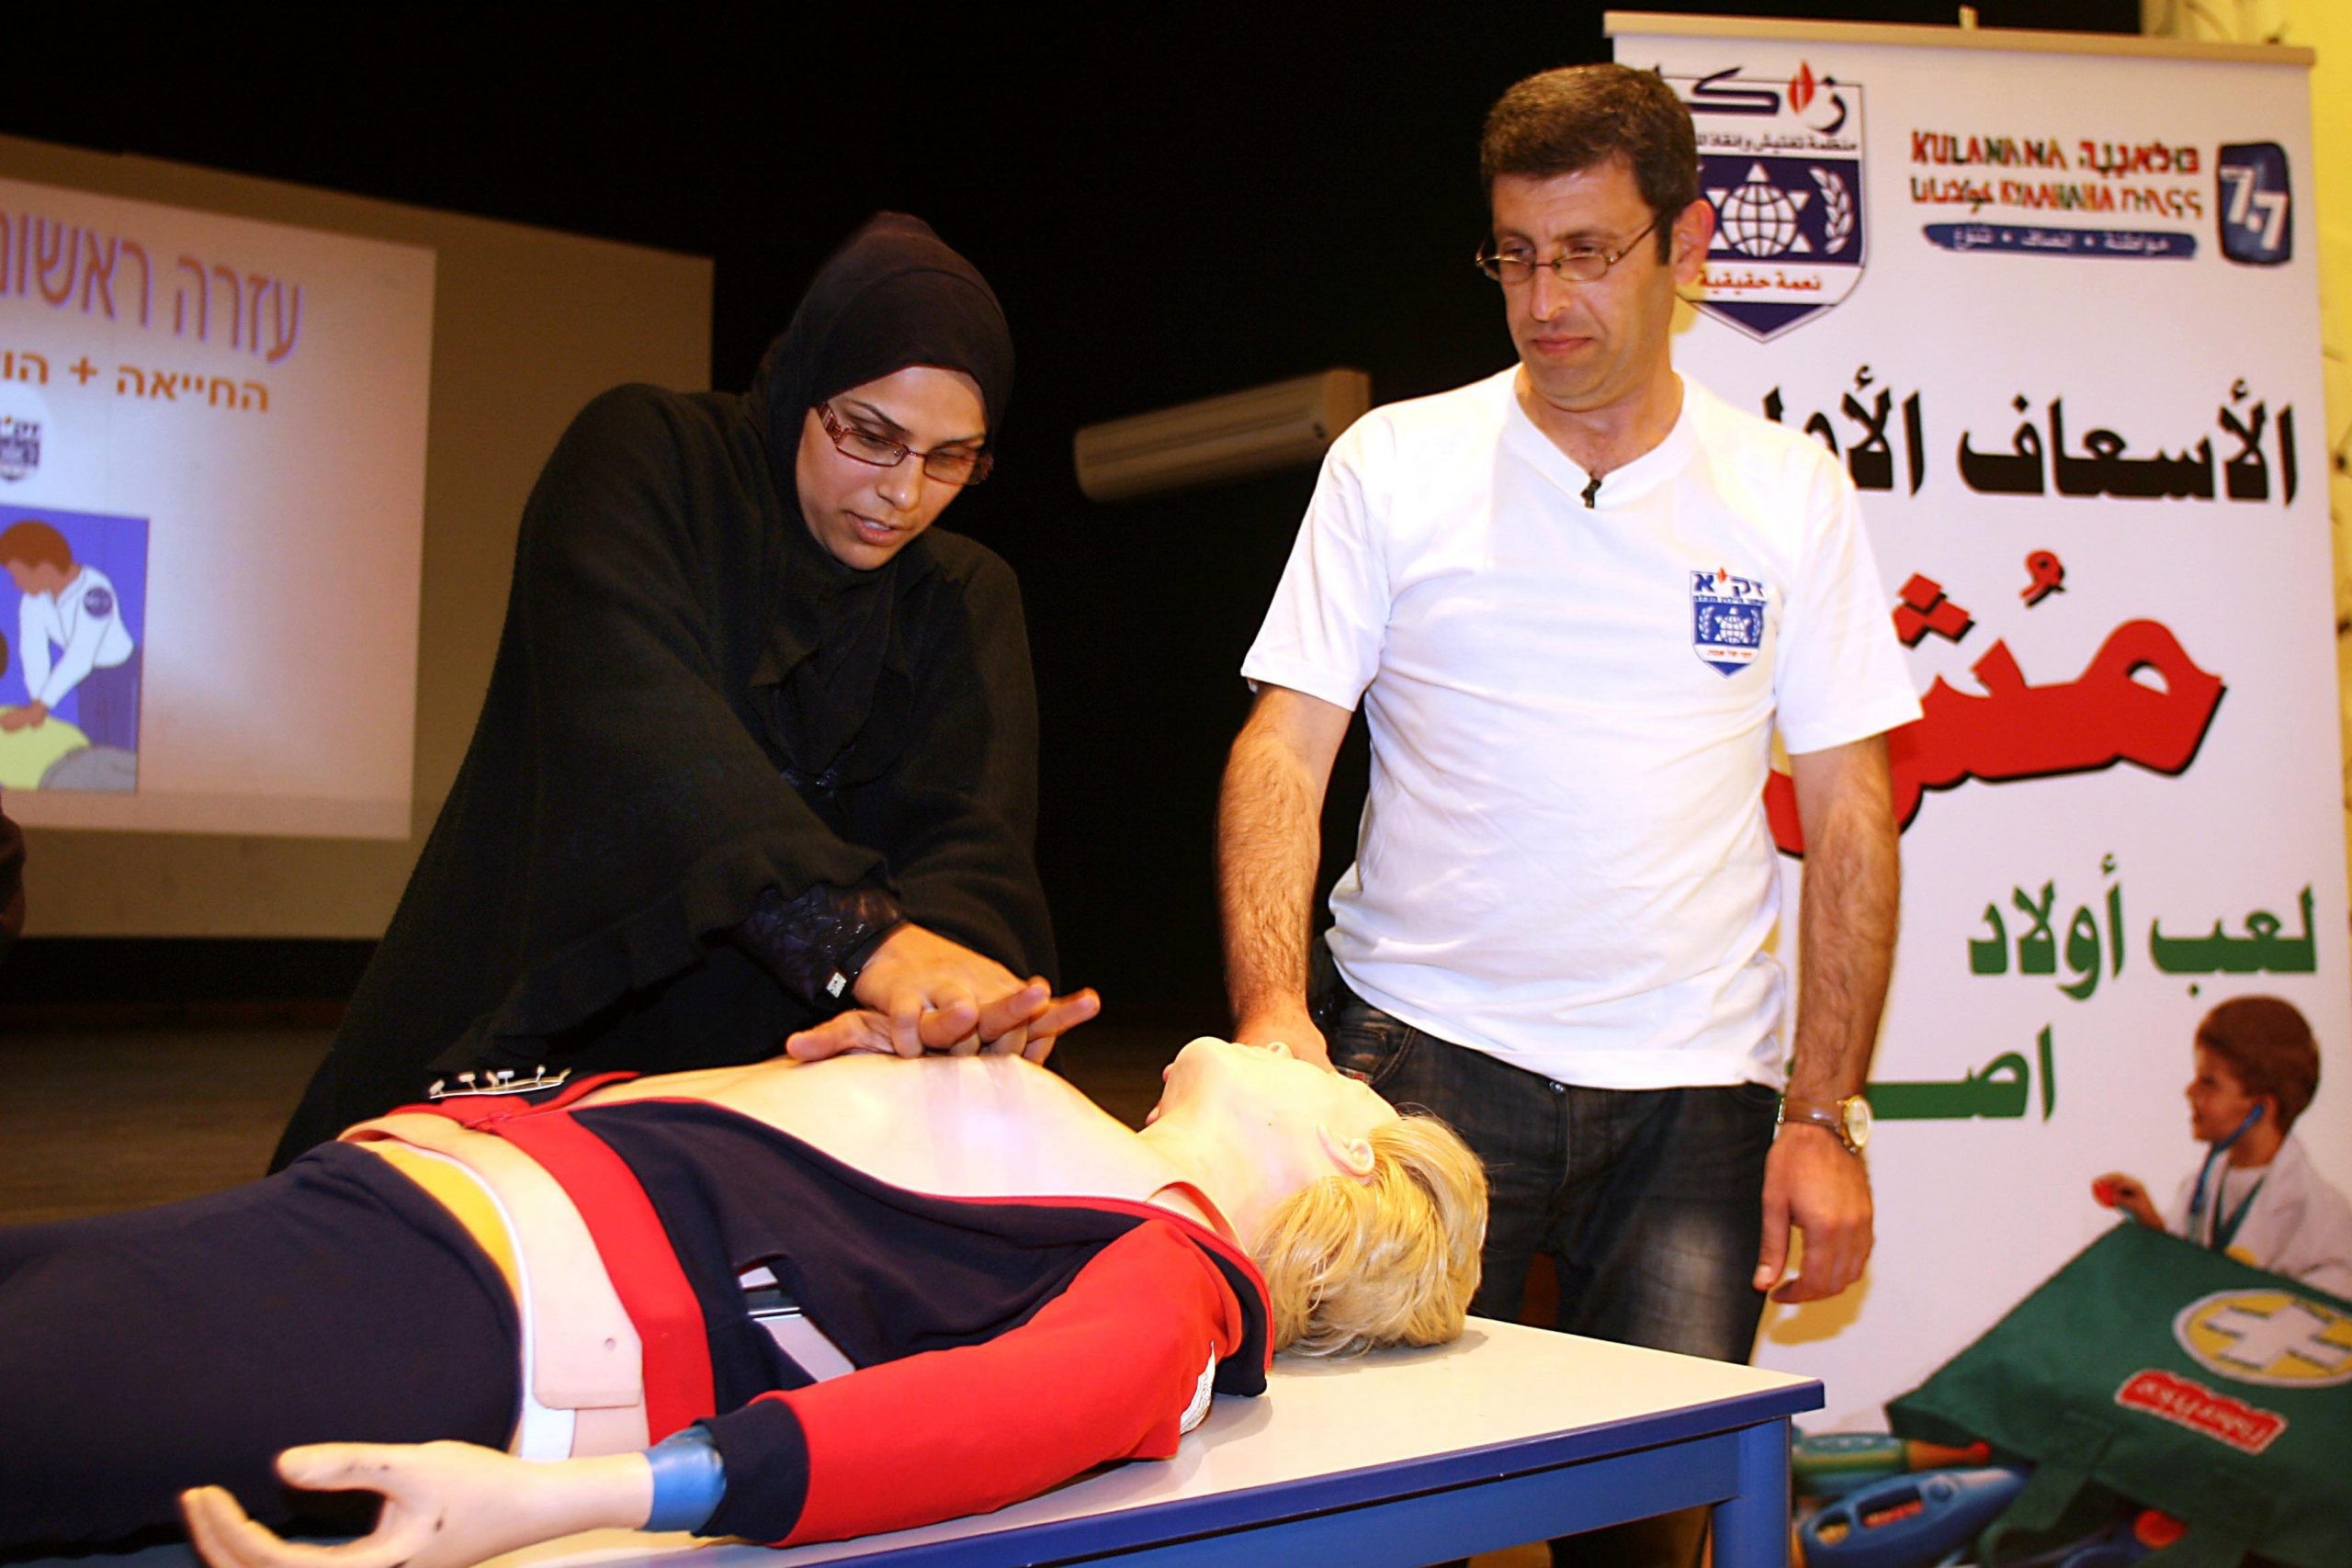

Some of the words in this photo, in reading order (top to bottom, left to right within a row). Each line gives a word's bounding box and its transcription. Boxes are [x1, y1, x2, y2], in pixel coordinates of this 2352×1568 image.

[1912, 131, 2068, 172] KULANANA
[175, 254, 305, 364] עזרה
[117, 364, 269, 413] החייאה
[1958, 377, 2298, 508] الأسعاف
[1968, 852, 2126, 1002] أولاد
[2149, 883, 2318, 998] لعب
